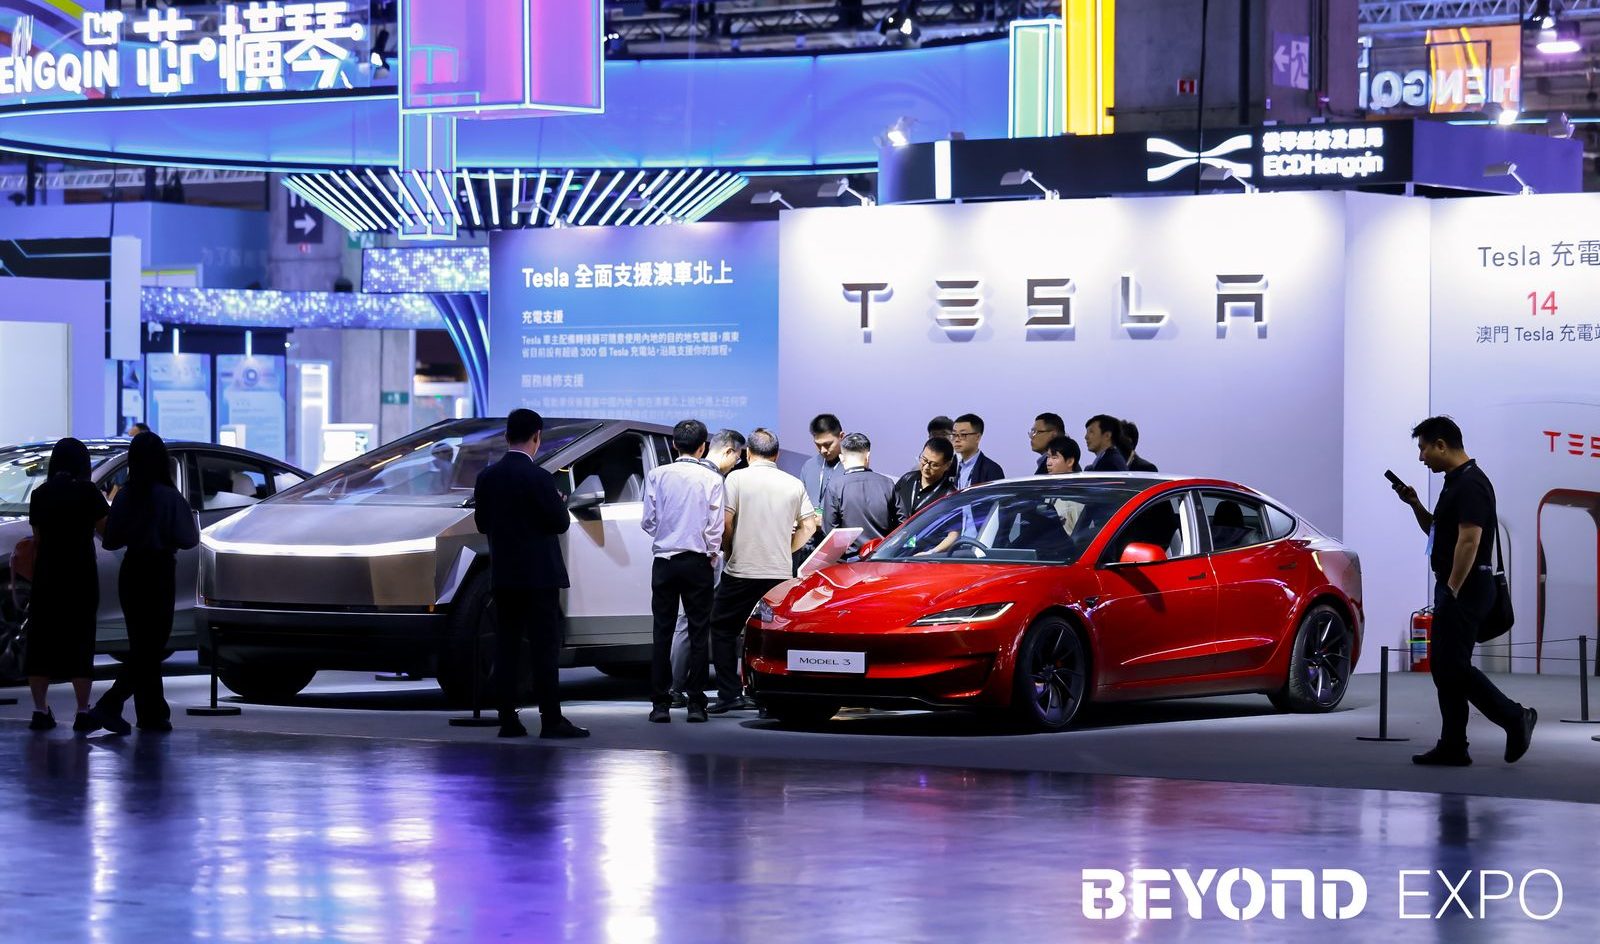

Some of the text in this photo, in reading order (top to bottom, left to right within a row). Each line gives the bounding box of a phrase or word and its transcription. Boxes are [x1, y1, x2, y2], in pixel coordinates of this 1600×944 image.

[1263, 151, 1383, 177] ECDHengqin
[1478, 240, 1600, 267] Tesla 充電
[522, 260, 733, 288] Tesla 全面支援澳車北上
[842, 273, 1267, 328] TESLA
[1527, 290, 1558, 316] 14
[521, 310, 564, 325] 充電支援
[521, 336, 542, 345] Tesla
[1476, 325, 1509, 343] 澳門
[1514, 325, 1554, 342] Tesla
[580, 347, 597, 358] 300
[609, 347, 629, 357] Tesla
[844, 658, 851, 666] 3
